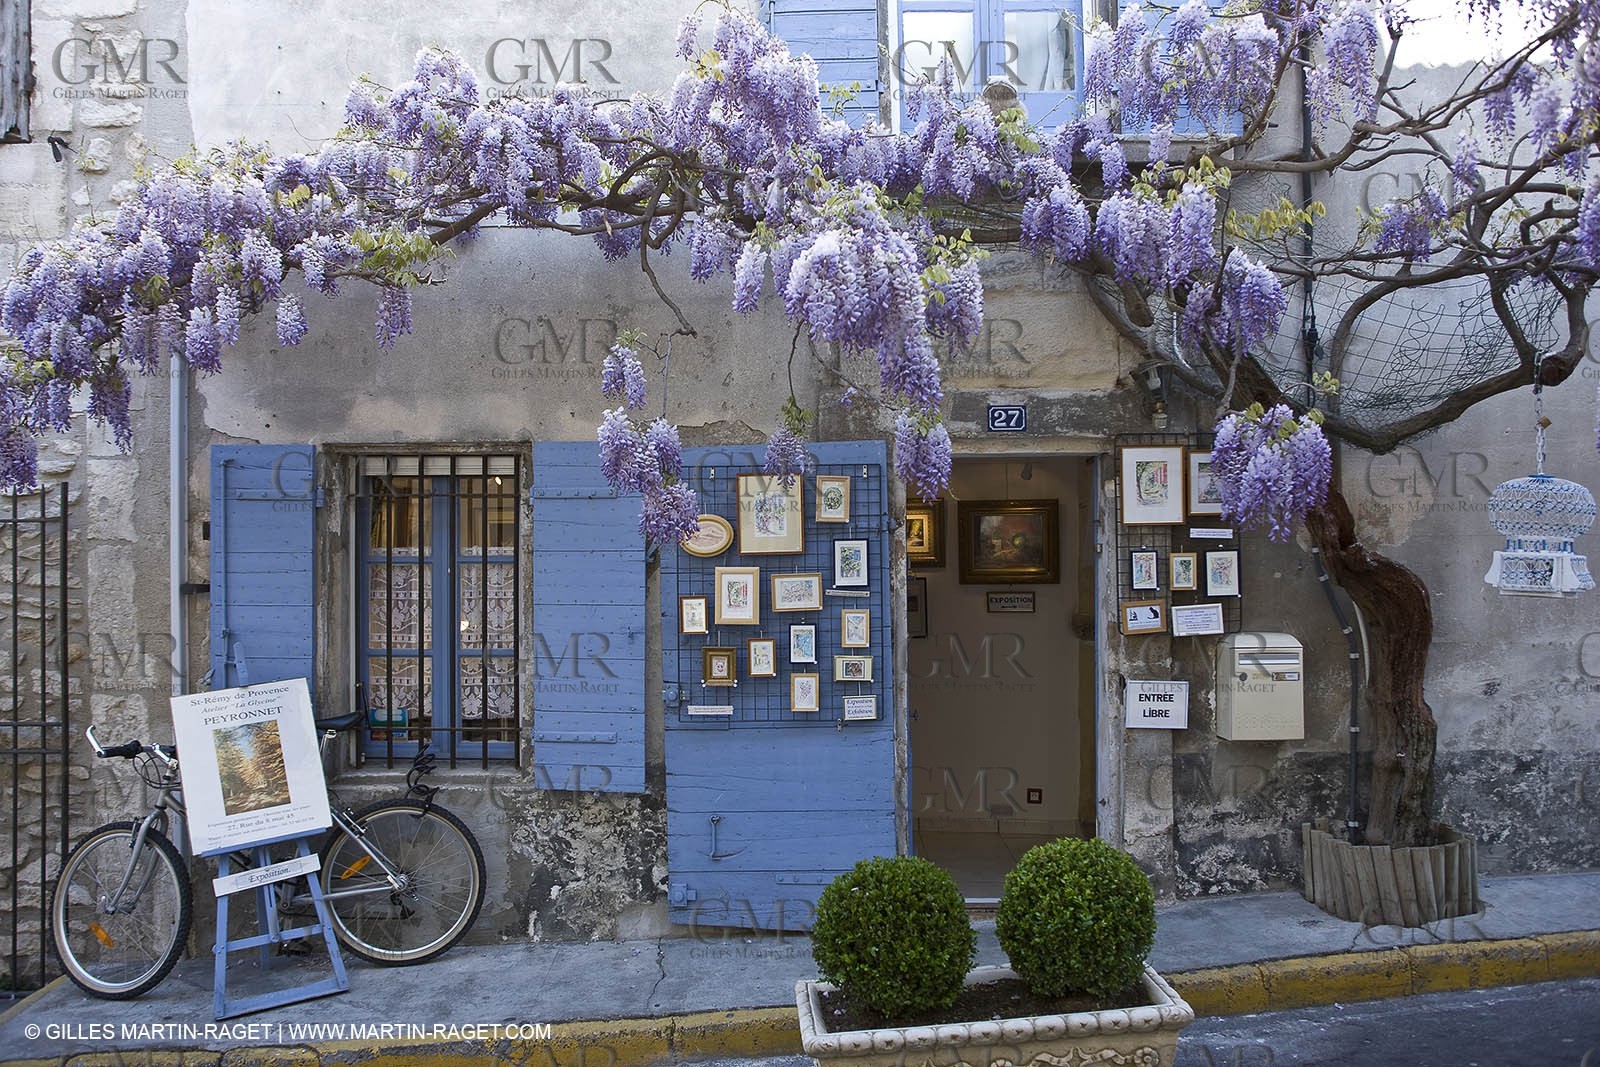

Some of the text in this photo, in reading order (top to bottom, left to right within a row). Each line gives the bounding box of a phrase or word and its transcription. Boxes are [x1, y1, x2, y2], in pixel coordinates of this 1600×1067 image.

[994, 410, 1020, 427] 27
[190, 685, 289, 707] St-Rémy de Provence
[1138, 691, 1175, 703] ENTRÉE
[201, 704, 228, 714] Atelier
[204, 705, 284, 726] PEYRONNET
